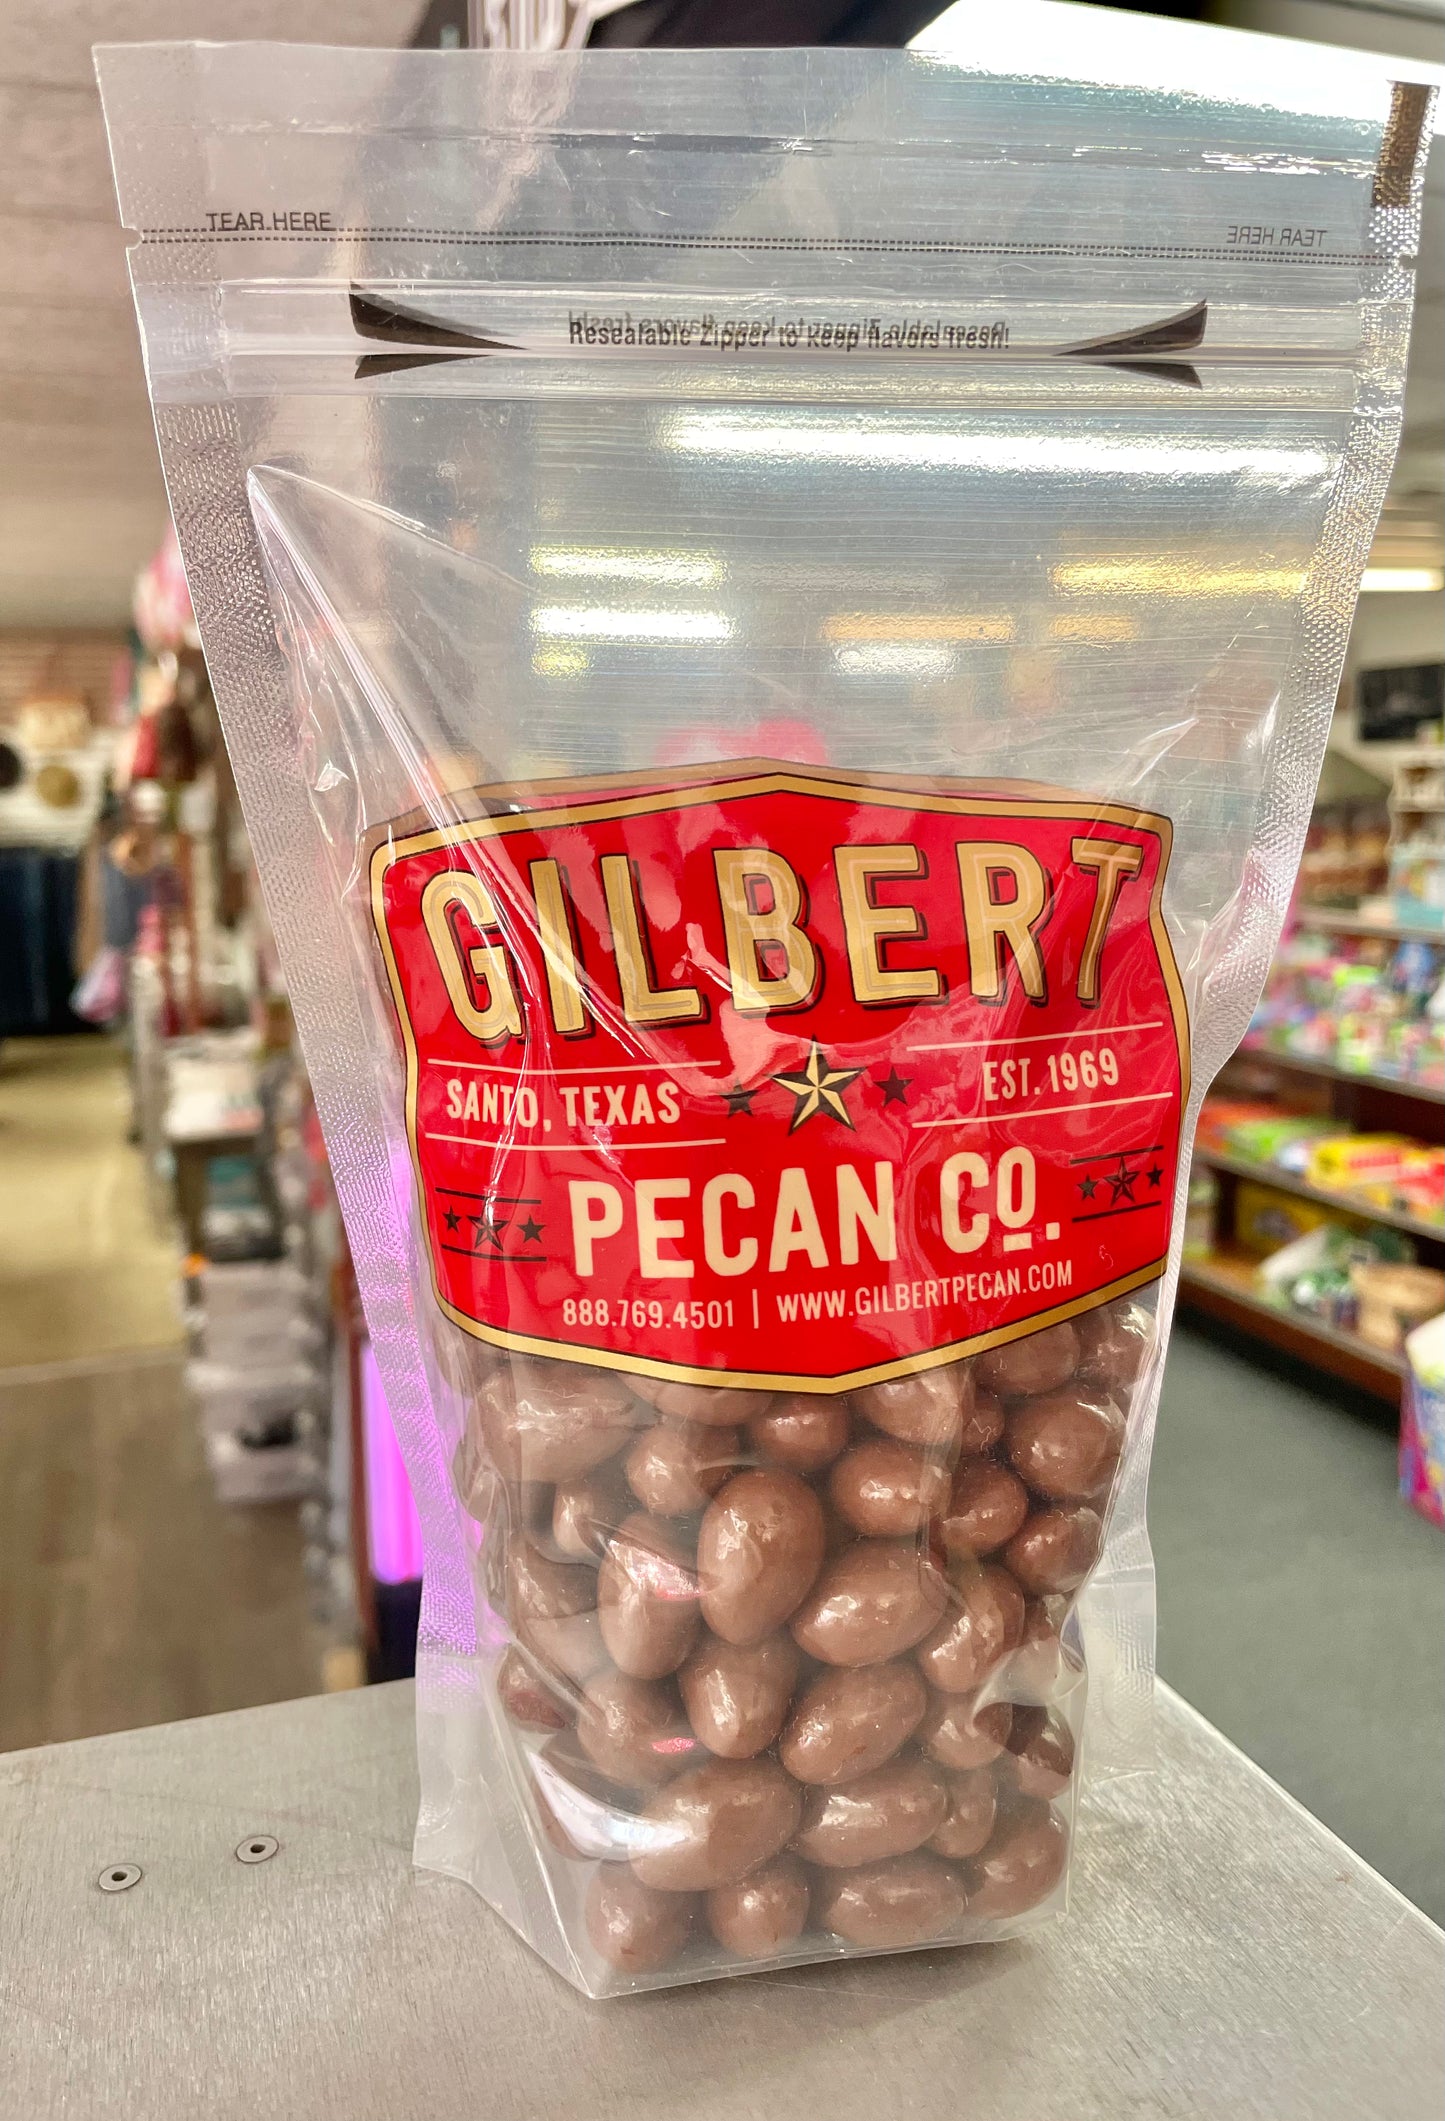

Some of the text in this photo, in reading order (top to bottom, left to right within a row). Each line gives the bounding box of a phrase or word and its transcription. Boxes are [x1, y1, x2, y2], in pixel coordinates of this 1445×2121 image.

[205, 211, 333, 231] TEAR HERE
[568, 321, 692, 346] Resealable
[700, 323, 771, 352] Zipper
[778, 325, 798, 348] to
[807, 325, 859, 352] keep
[420, 837, 1145, 1043] GILBERT
[982, 1047, 1120, 1101] EST. 1969
[446, 1078, 682, 1132] SANTO, TEXAS
[568, 1160, 897, 1279] PECAN
[562, 1259, 1073, 1330] 888.769.4501 WWW.GILBERTPECAN.COM
